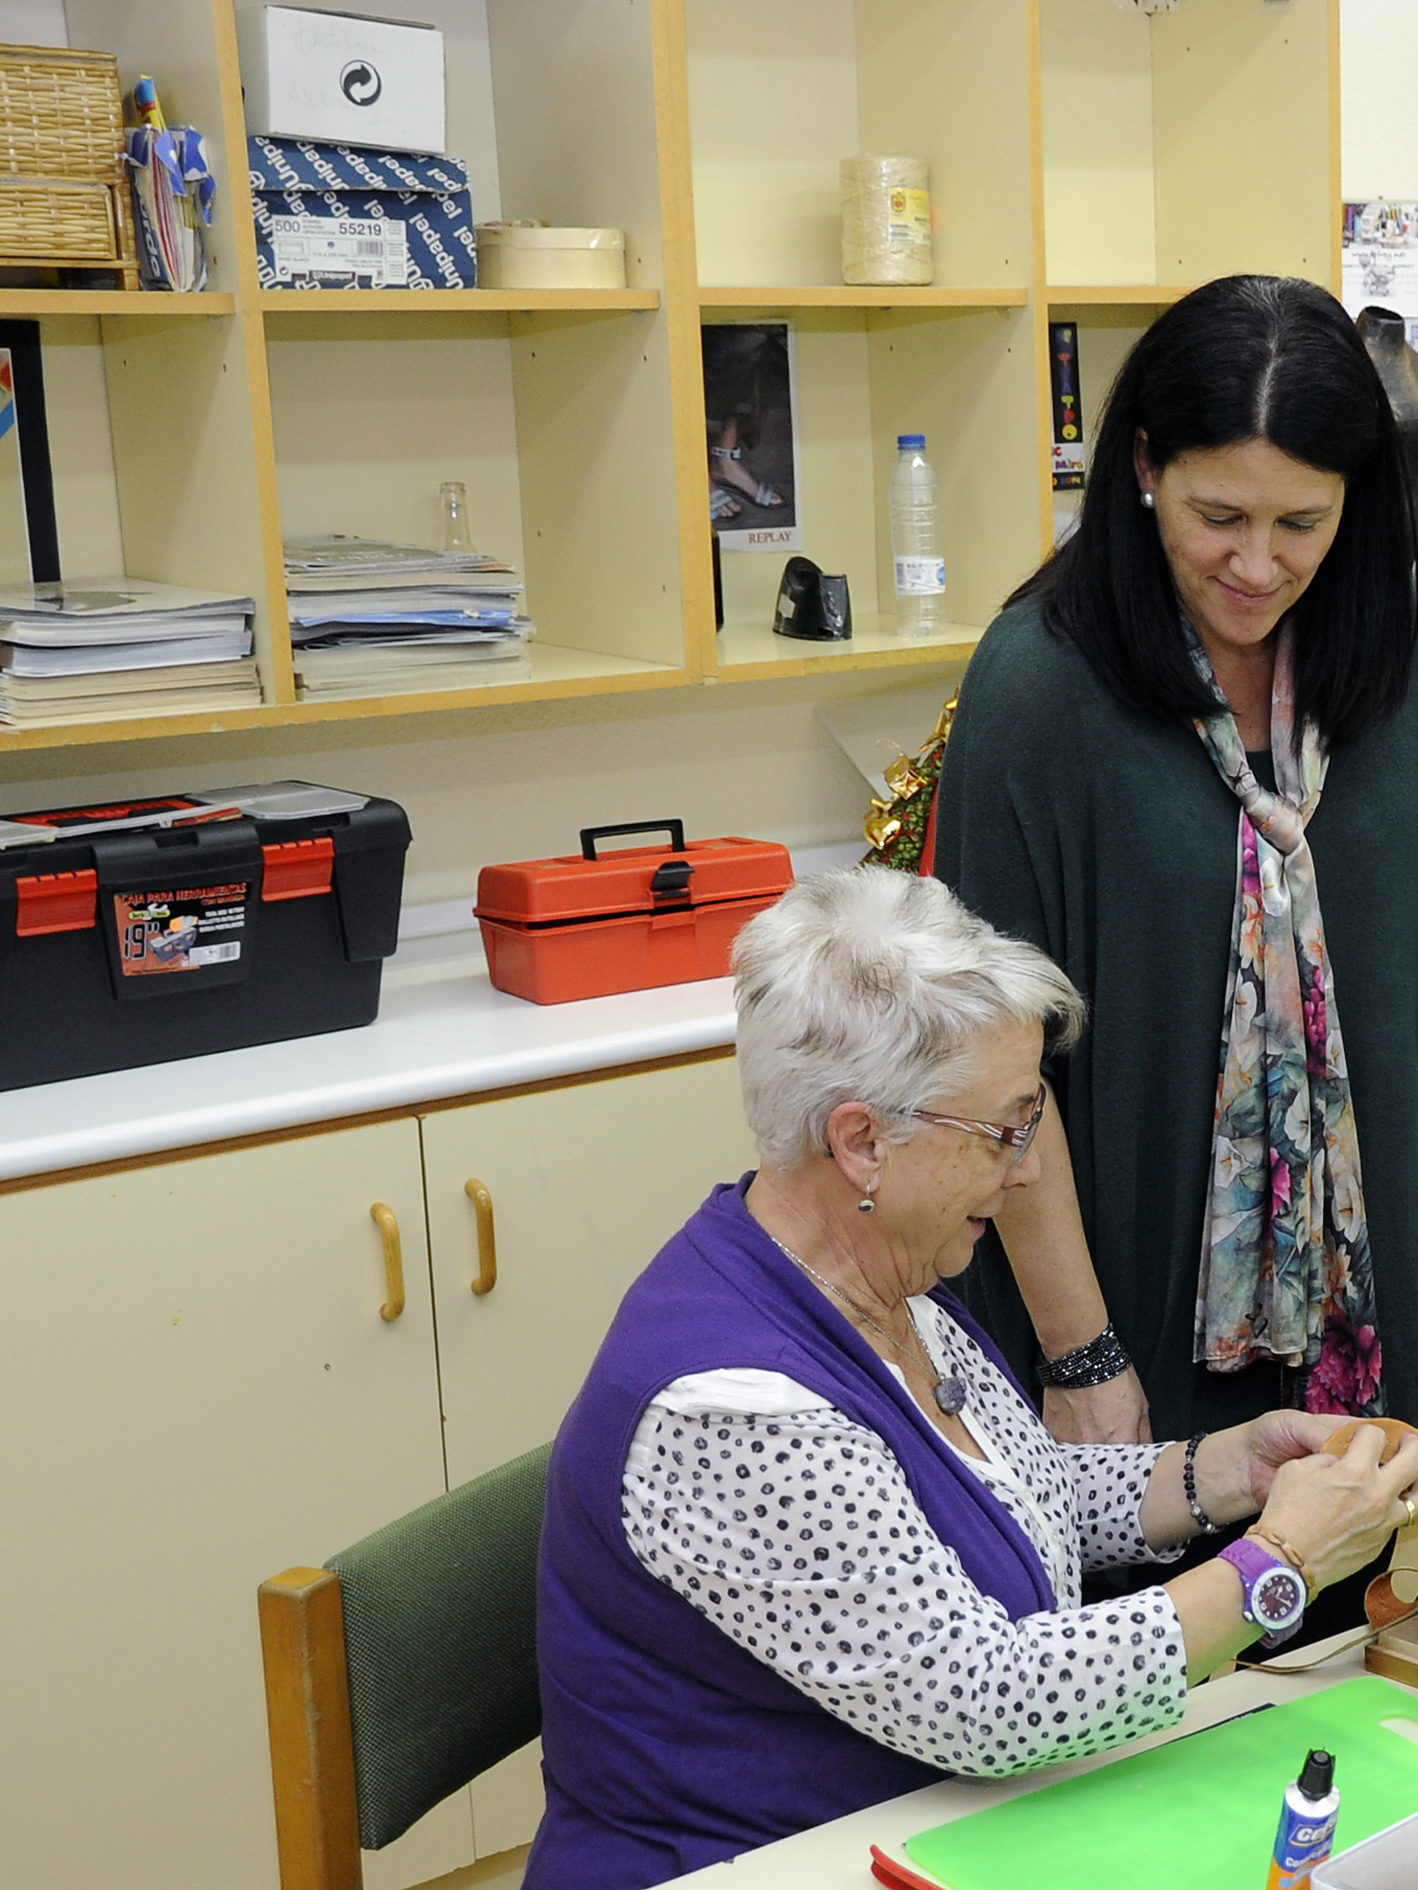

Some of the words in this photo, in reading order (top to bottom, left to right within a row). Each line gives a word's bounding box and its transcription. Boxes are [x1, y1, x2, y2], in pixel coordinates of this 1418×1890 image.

[274, 220, 300, 233] 500
[338, 222, 382, 236] 55219
[748, 531, 791, 544] REPLAY
[120, 892, 145, 906] CAJA
[147, 891, 175, 903] PARA
